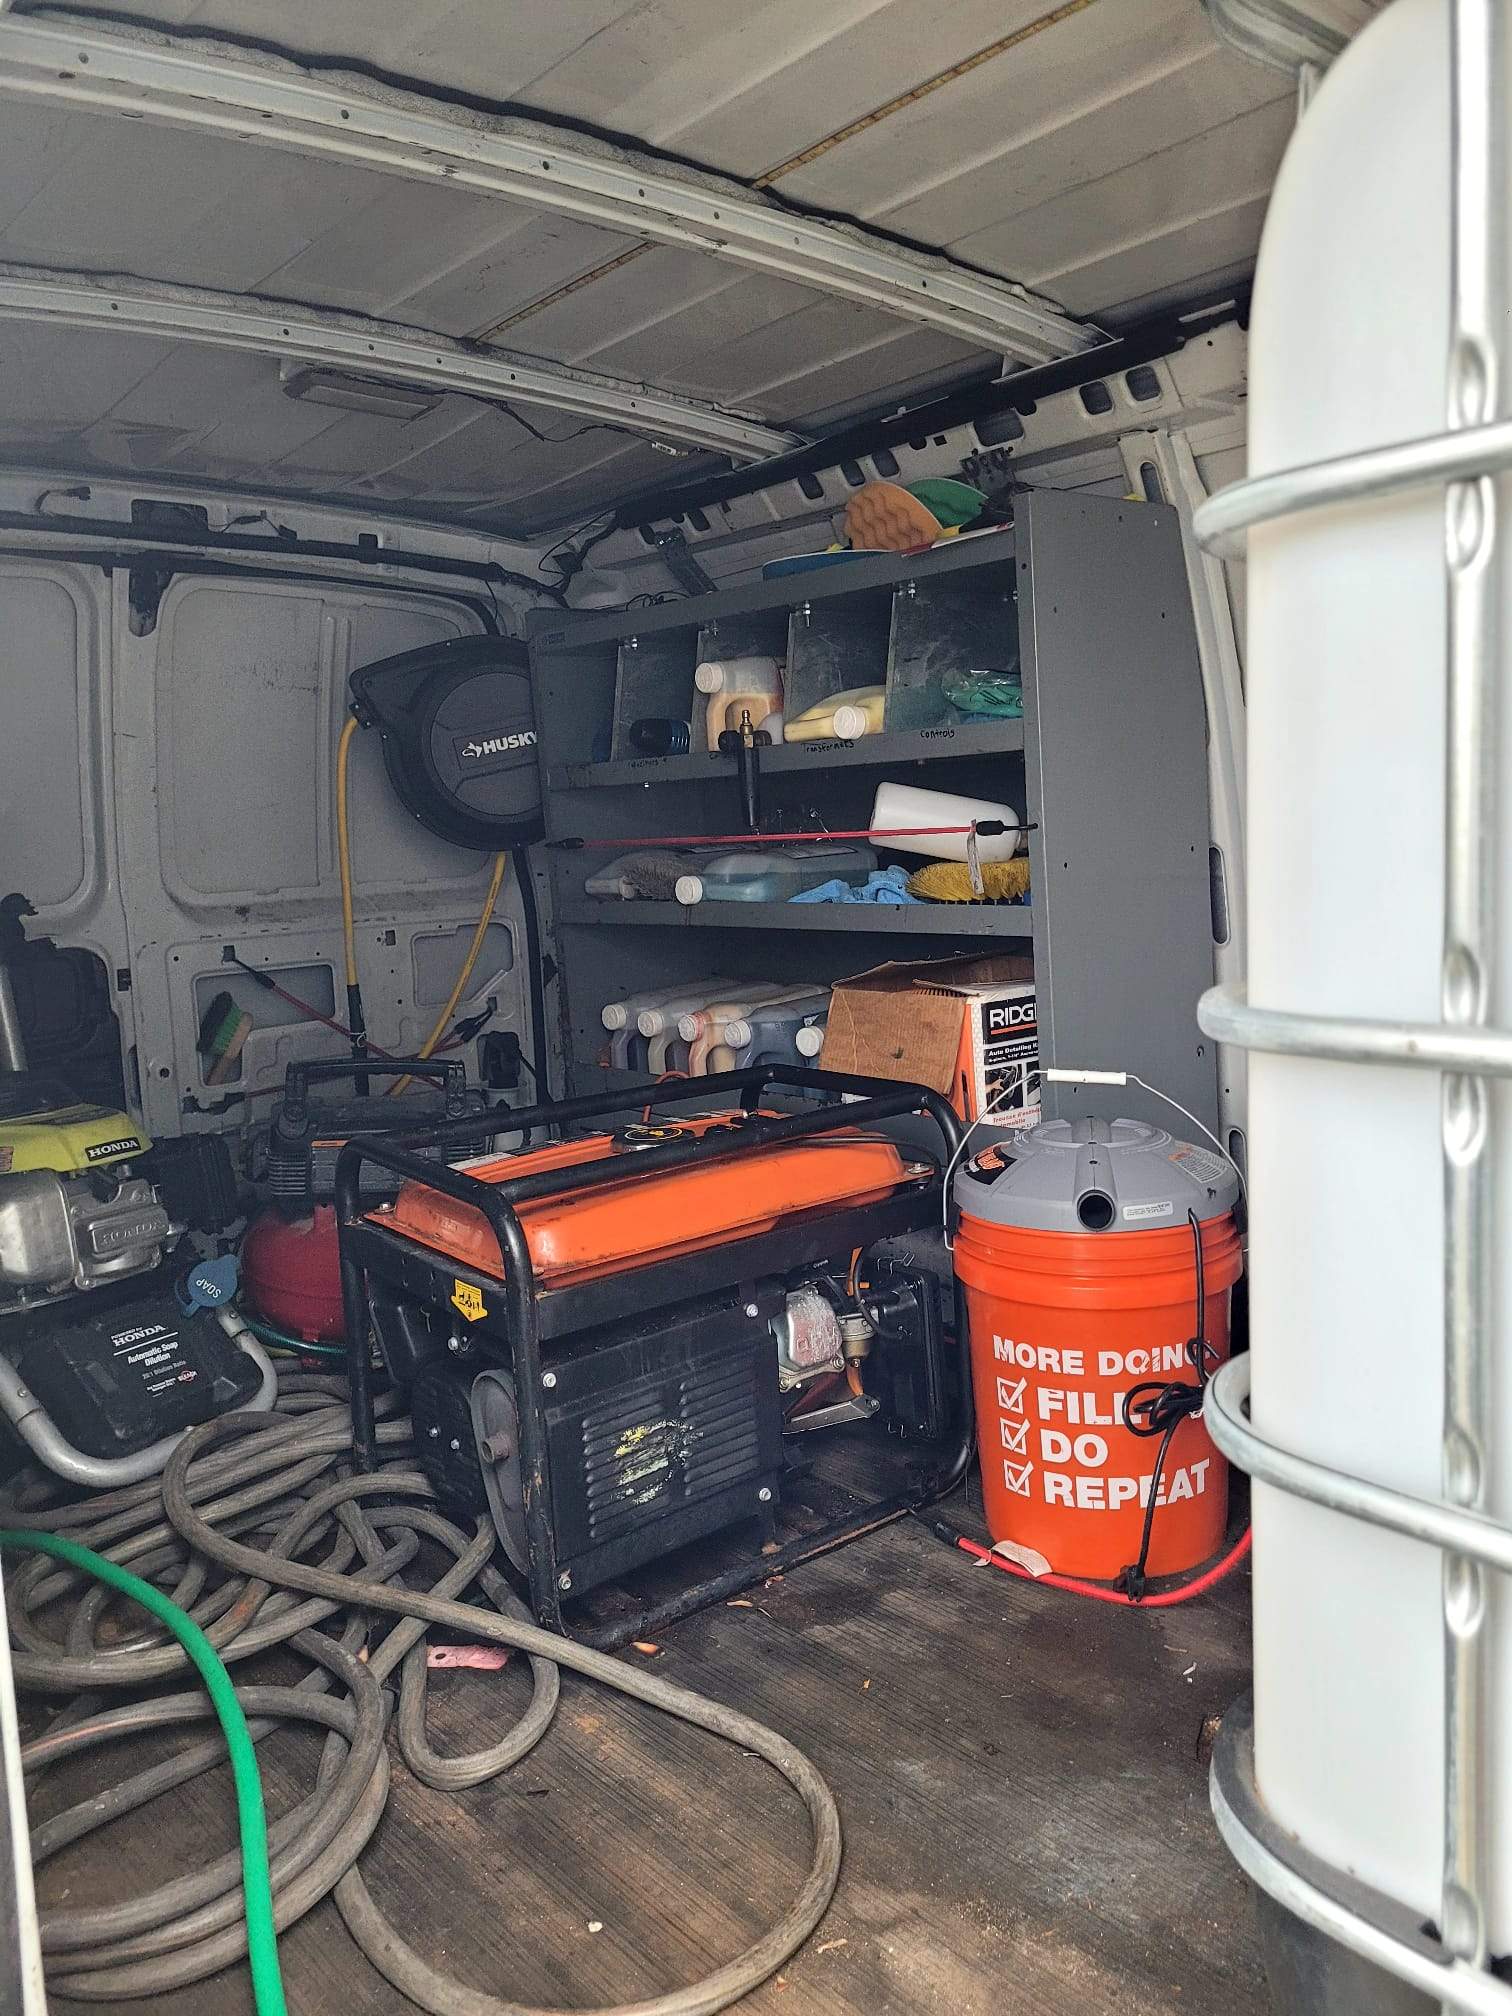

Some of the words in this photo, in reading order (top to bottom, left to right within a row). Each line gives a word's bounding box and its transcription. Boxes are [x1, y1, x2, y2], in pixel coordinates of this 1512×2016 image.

[482, 731, 537, 754] HUSKY
[988, 1049, 1004, 1057] Auto
[88, 1139, 138, 1159] HONDA
[196, 1278, 221, 1298] SOAP
[112, 1324, 167, 1347] HONDA
[127, 1347, 162, 1365] Automatic
[161, 1341, 179, 1352] Soap
[144, 1352, 171, 1367] Dilution
[993, 1335, 1085, 1376] MORE
[1037, 1387, 1142, 1425] FILL
[1040, 1429, 1109, 1468] DO
[1043, 1458, 1210, 1511] REPEAT
